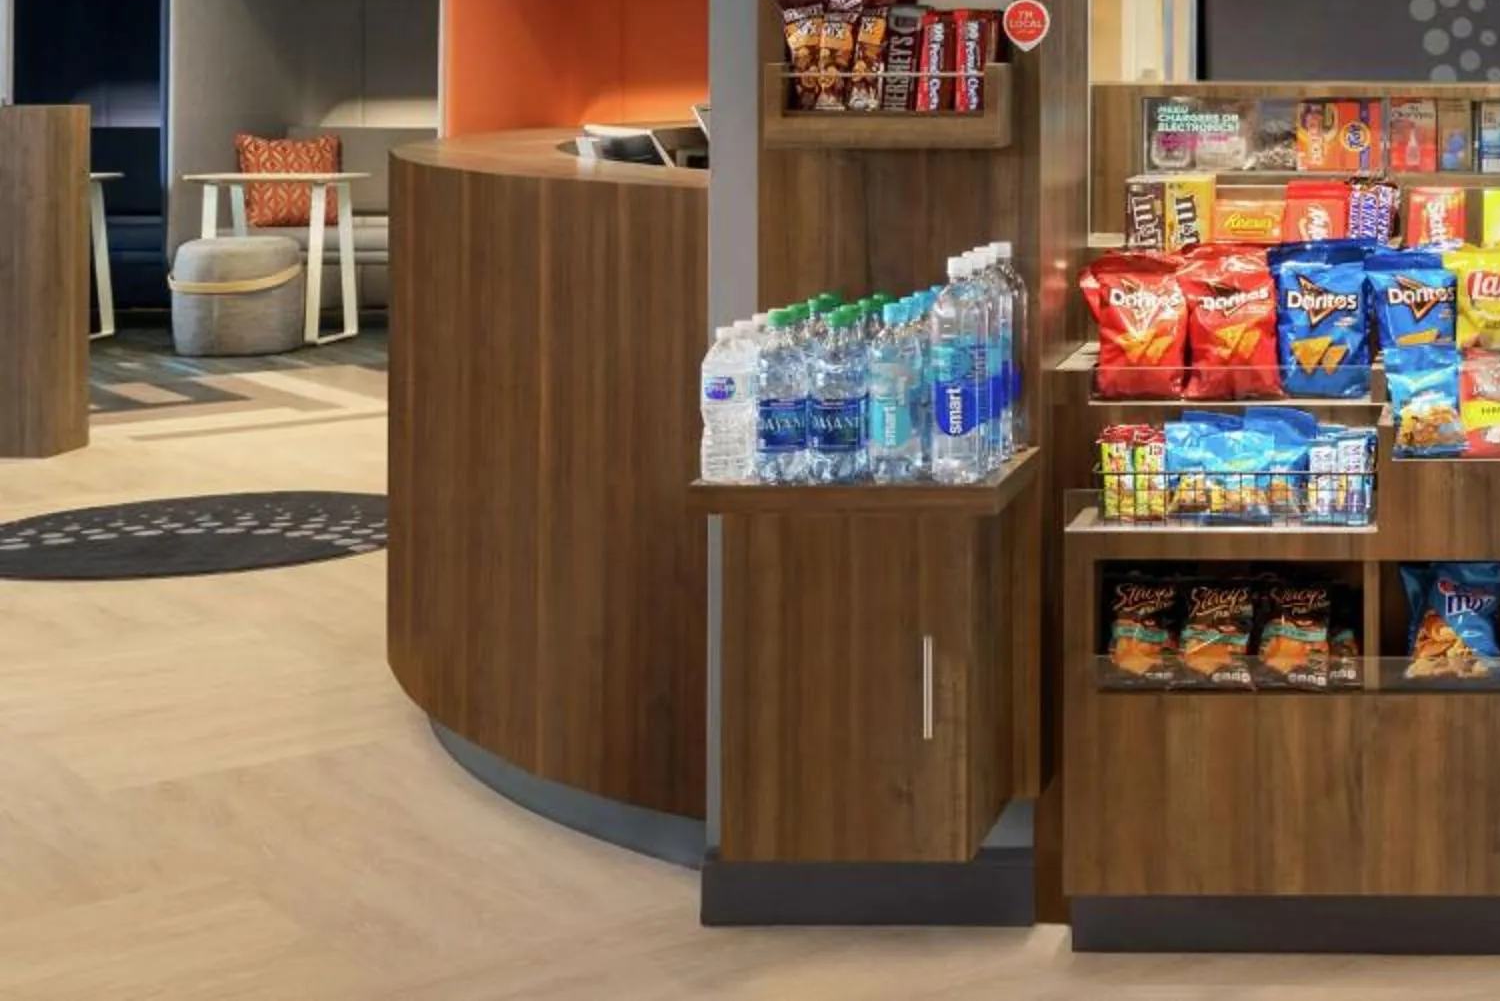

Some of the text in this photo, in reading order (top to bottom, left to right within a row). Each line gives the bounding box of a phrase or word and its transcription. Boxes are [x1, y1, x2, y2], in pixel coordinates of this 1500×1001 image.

[1008, 18, 1043, 29] LOCAL
[1109, 288, 1182, 310] Doritos
[1199, 287, 1269, 312] Doritos
[1287, 290, 1358, 310] Doritos
[1388, 286, 1456, 304] Doritos
[947, 387, 963, 437] smart
[884, 406, 897, 446] smart
